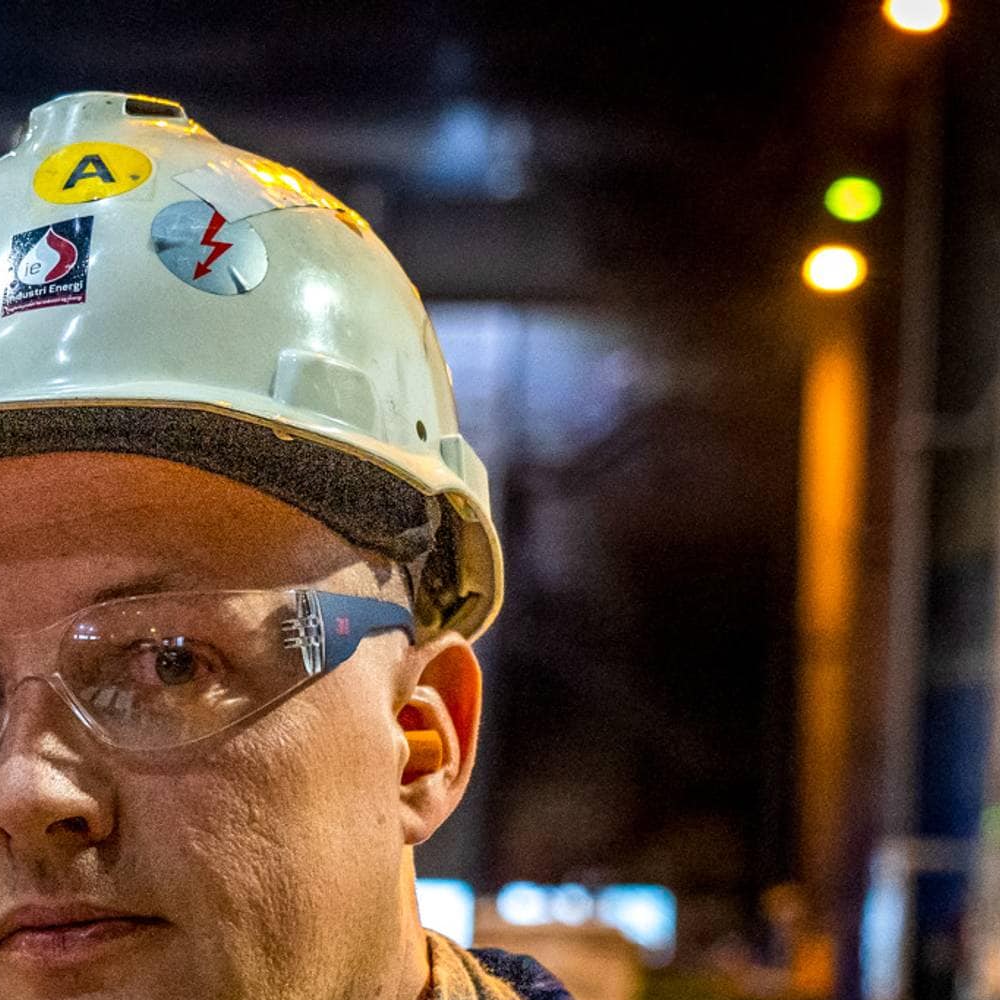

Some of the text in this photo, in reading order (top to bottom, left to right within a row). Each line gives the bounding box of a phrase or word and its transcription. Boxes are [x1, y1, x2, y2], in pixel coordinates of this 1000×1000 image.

[62, 154, 116, 191] A
[24, 262, 42, 277] ie
[49, 280, 84, 293] Energi
